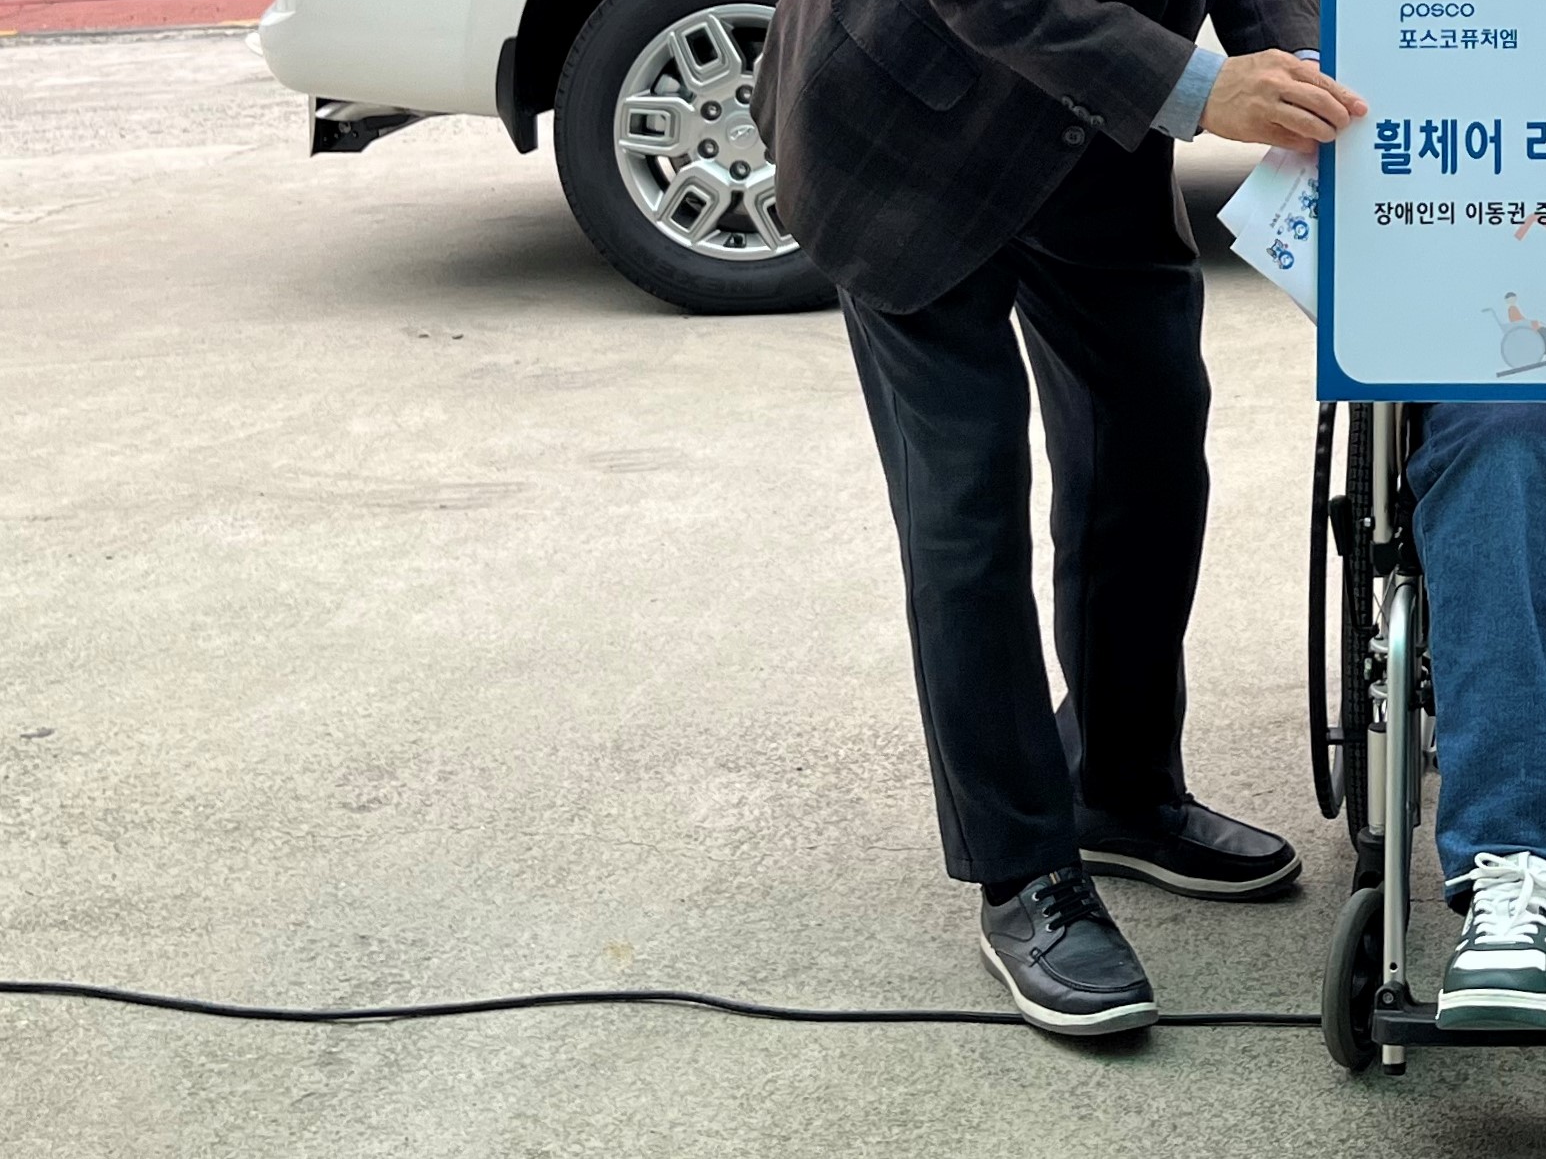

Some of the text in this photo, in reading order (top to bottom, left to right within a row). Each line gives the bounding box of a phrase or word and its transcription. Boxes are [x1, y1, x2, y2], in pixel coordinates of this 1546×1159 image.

[1399, 1, 1475, 22] posco
[1399, 28, 1518, 50] 포스코퓨처엠
[1374, 119, 1502, 175] 휠체어
[1374, 201, 1456, 226] 장애인의
[1465, 201, 1526, 226] 이동권
